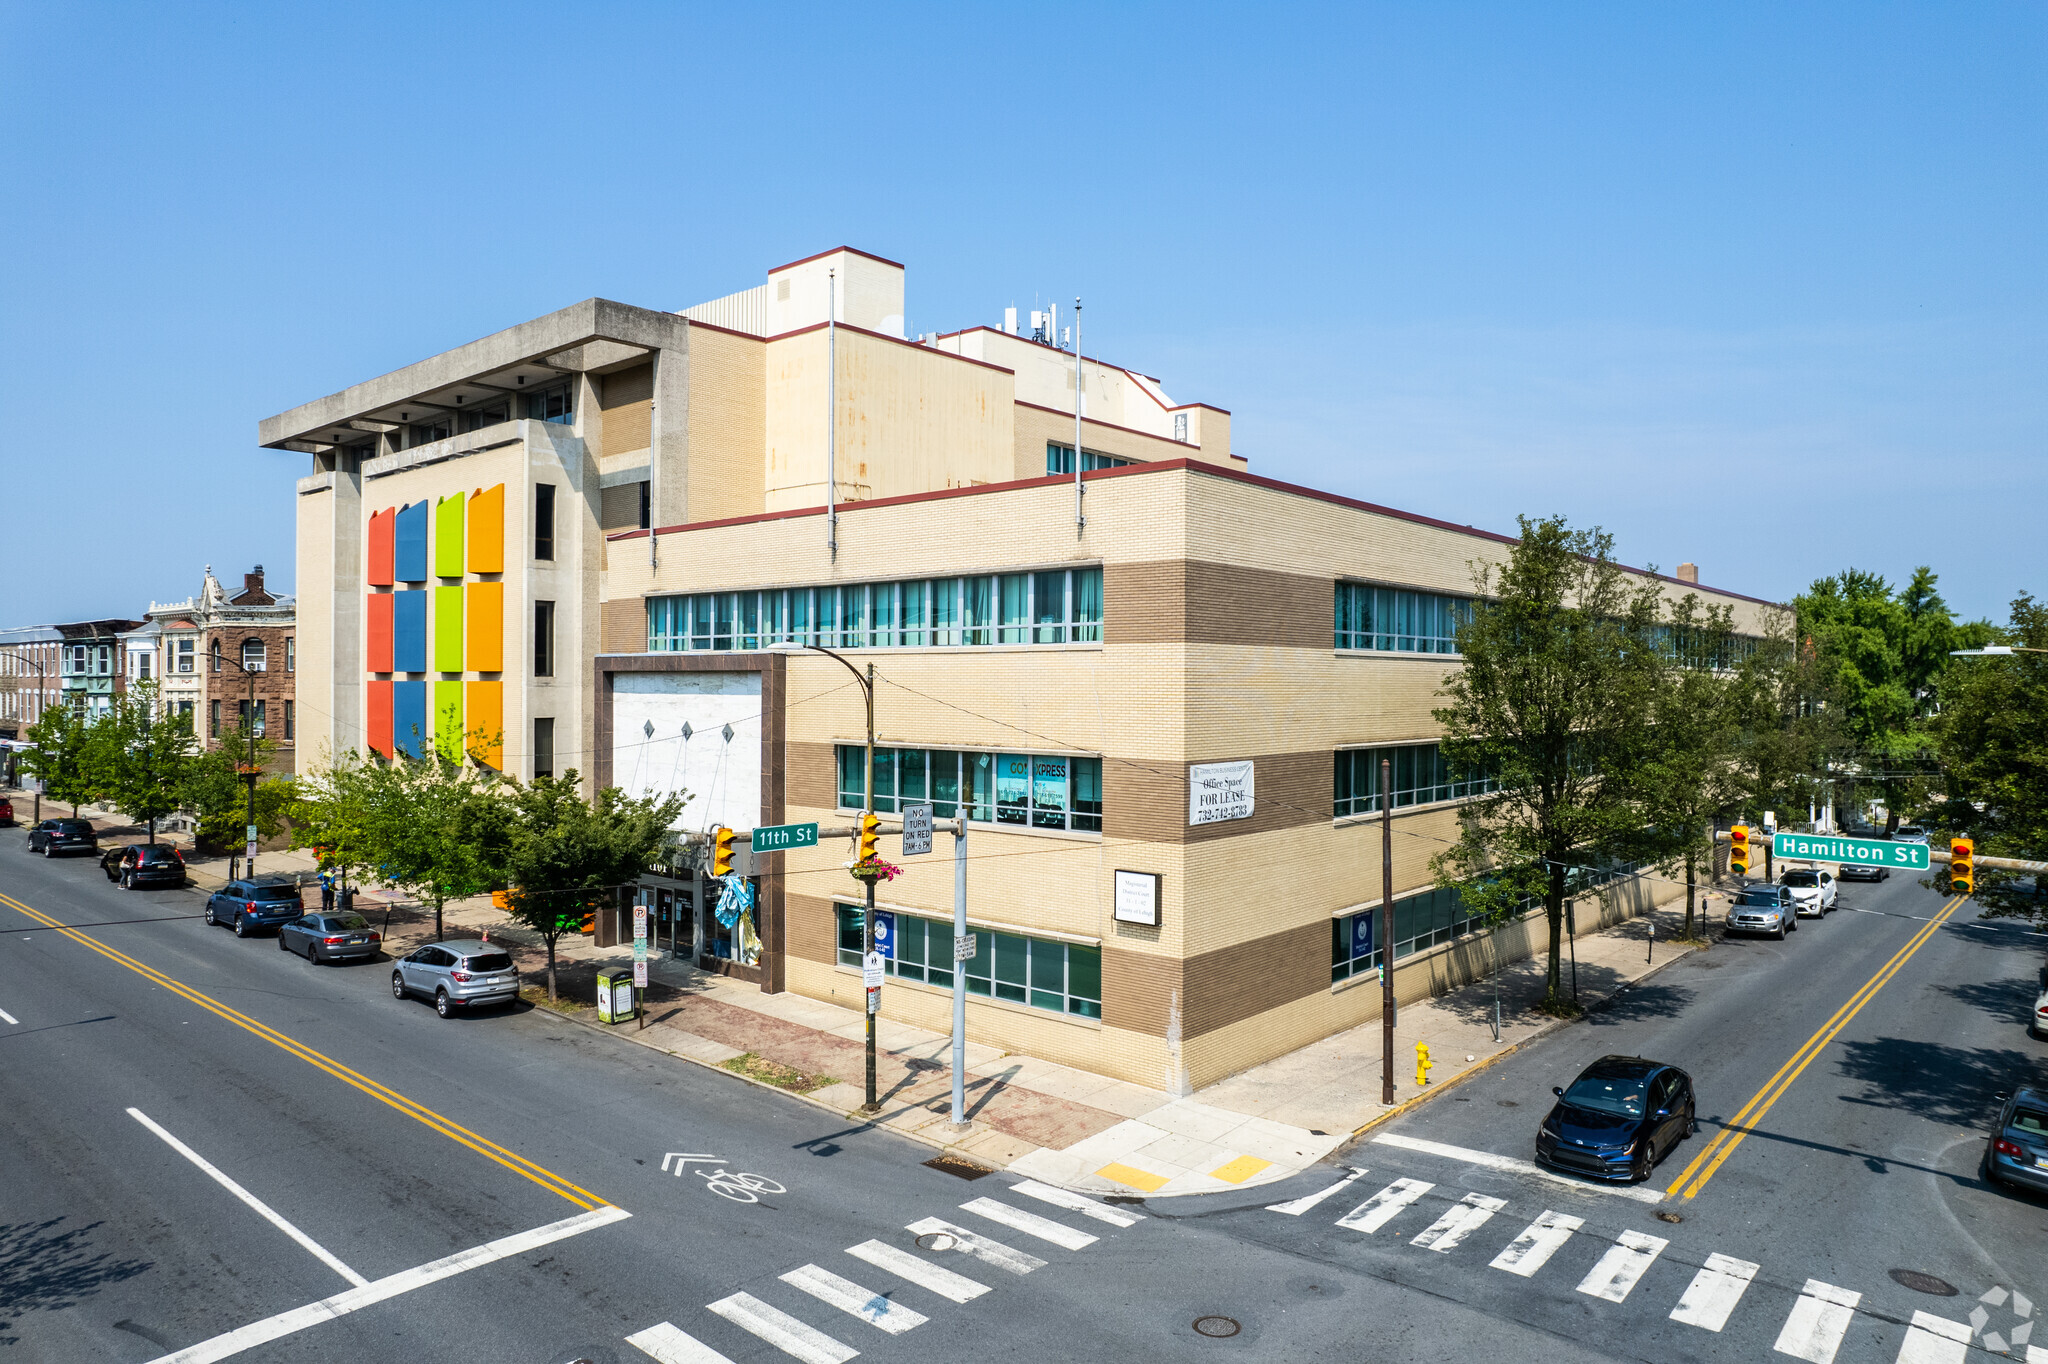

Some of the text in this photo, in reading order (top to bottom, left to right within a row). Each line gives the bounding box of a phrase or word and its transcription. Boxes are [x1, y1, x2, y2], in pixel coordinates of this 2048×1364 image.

[1204, 777, 1242, 790] Office Space
[1200, 790, 1246, 807] FOR LEASE
[912, 808, 924, 817] NO
[1198, 804, 1248, 822] 732-742-8783
[909, 819, 927, 829] TURN
[760, 828, 812, 846] 11th St
[905, 829, 930, 840] ON RED
[1783, 837, 1918, 864] Hamilton St
